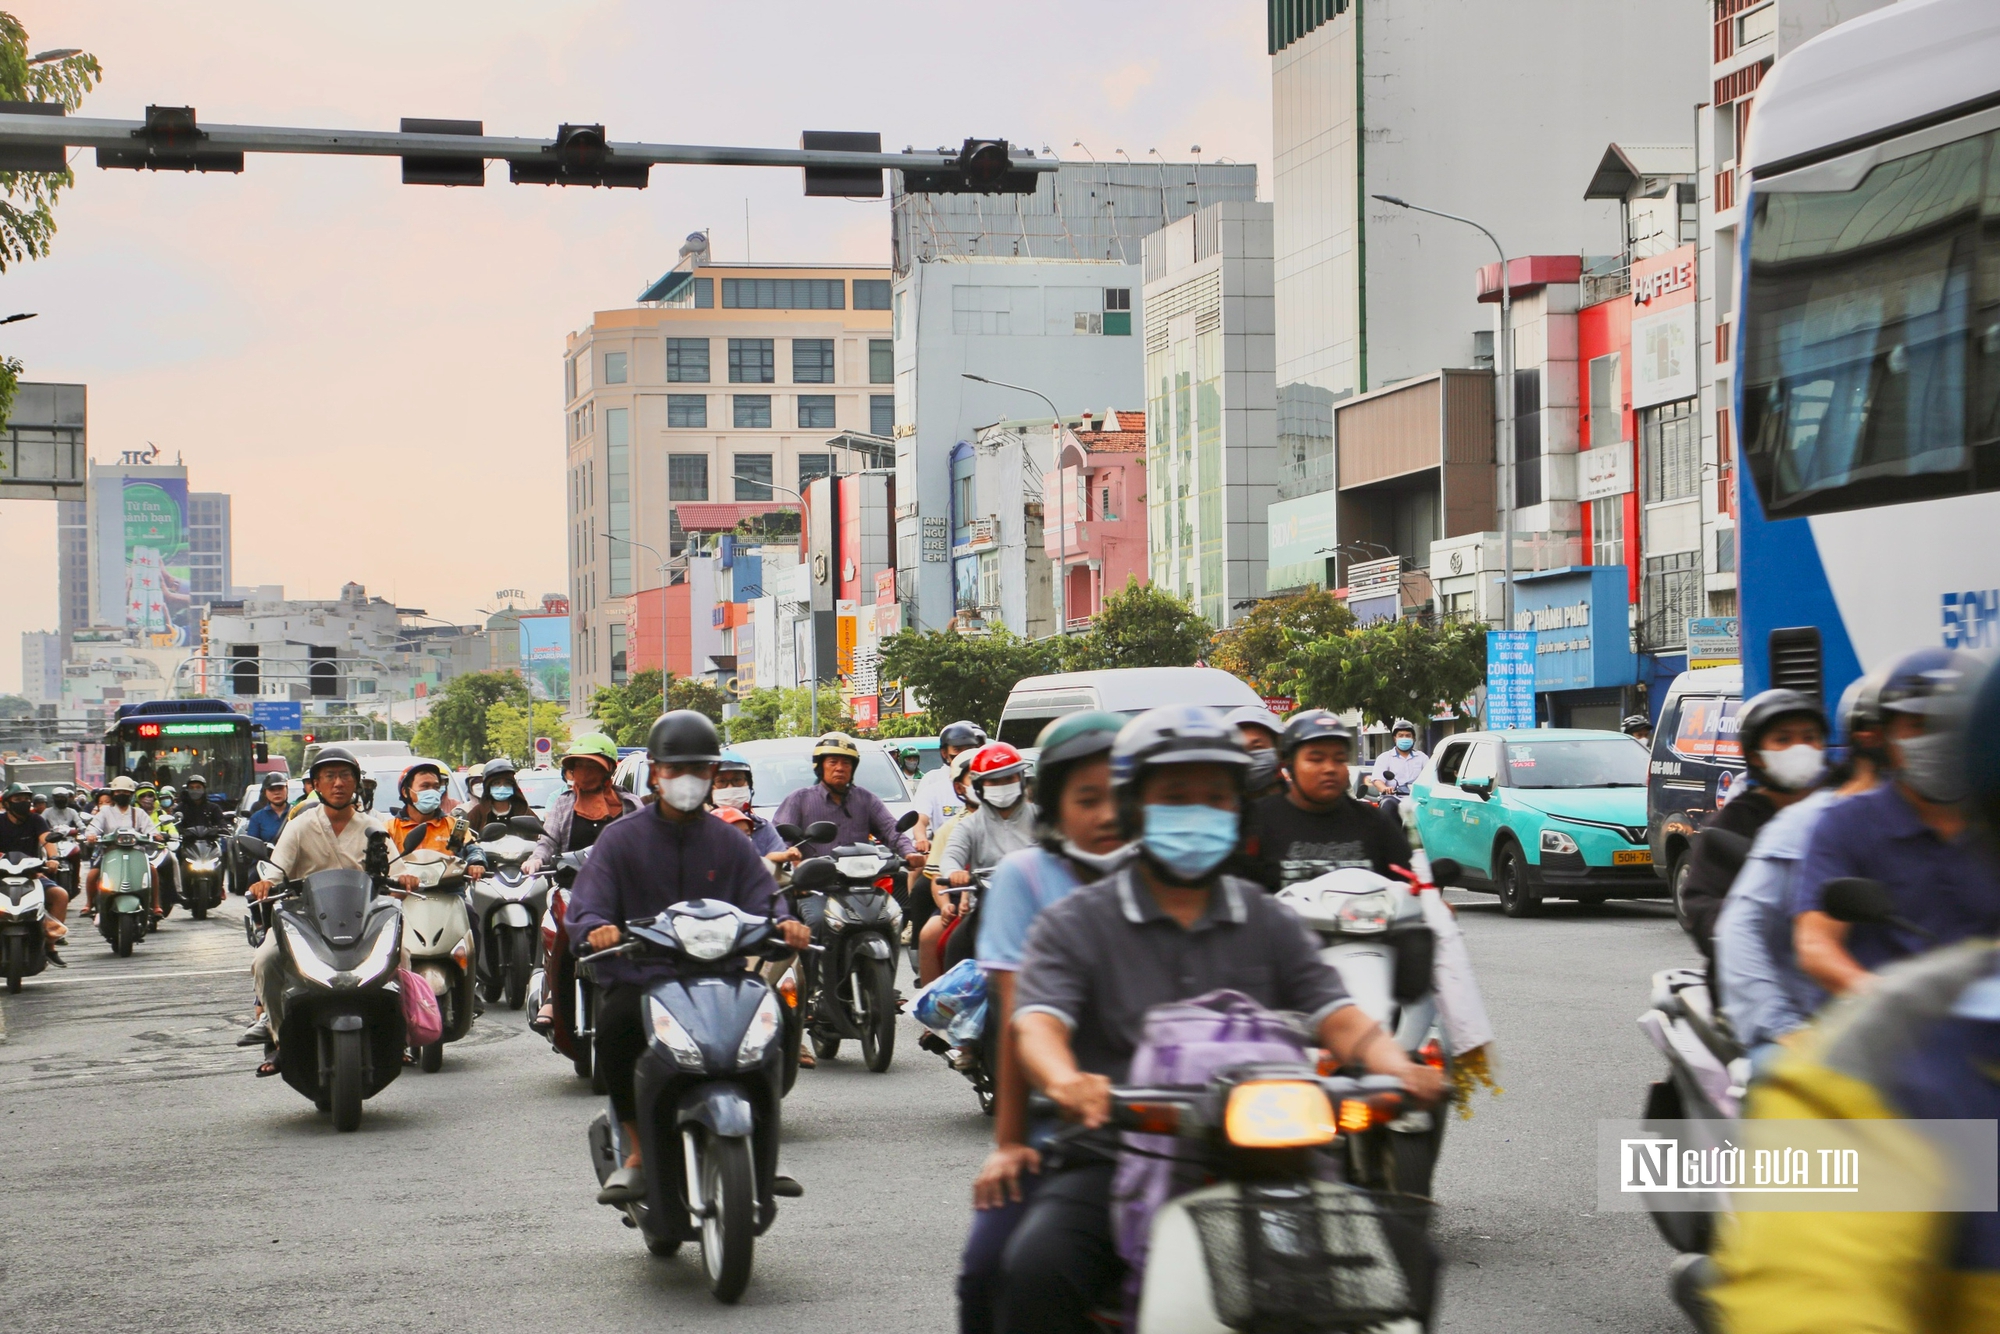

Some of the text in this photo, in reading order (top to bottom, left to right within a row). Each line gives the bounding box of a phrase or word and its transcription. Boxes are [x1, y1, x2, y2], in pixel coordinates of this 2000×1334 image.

[122, 450, 152, 465] TTC
[126, 501, 160, 511] Từ fan
[150, 512, 171, 525] bạn
[924, 517, 946, 526] ANH
[927, 553, 943, 562] EM
[496, 588, 526, 600] HOTEL
[1534, 604, 1564, 631] THÀNH
[1565, 599, 1590, 628] PHÁT
[1487, 660, 1534, 677] CỘNG HÒA
[140, 724, 159, 736] 104
